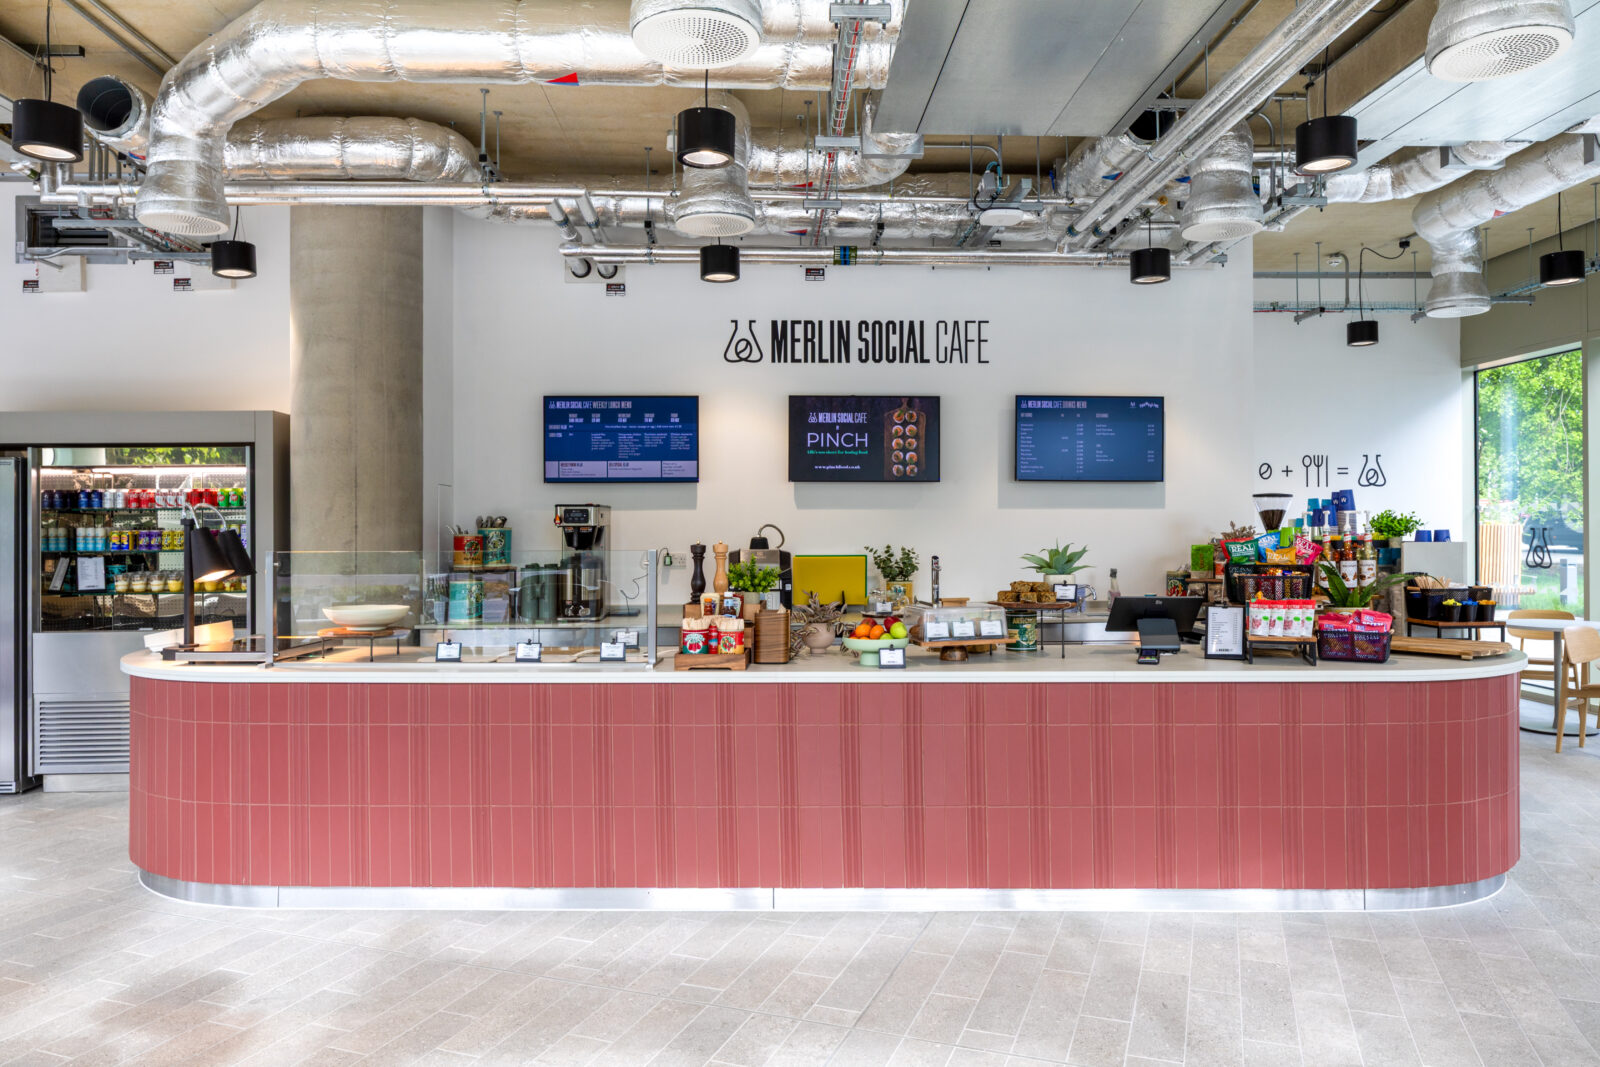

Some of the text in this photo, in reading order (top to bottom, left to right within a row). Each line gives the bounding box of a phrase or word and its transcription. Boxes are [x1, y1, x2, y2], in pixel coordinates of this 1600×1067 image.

[771, 320, 990, 364] MERLIN SOCIAL CAFE
[819, 412, 867, 423] MERLIN SOCIAL CAFE
[807, 432, 868, 448] PINCH
[1231, 544, 1254, 553] REAL
[1296, 538, 1316, 552] REAL
[1267, 551, 1289, 560] REAL
